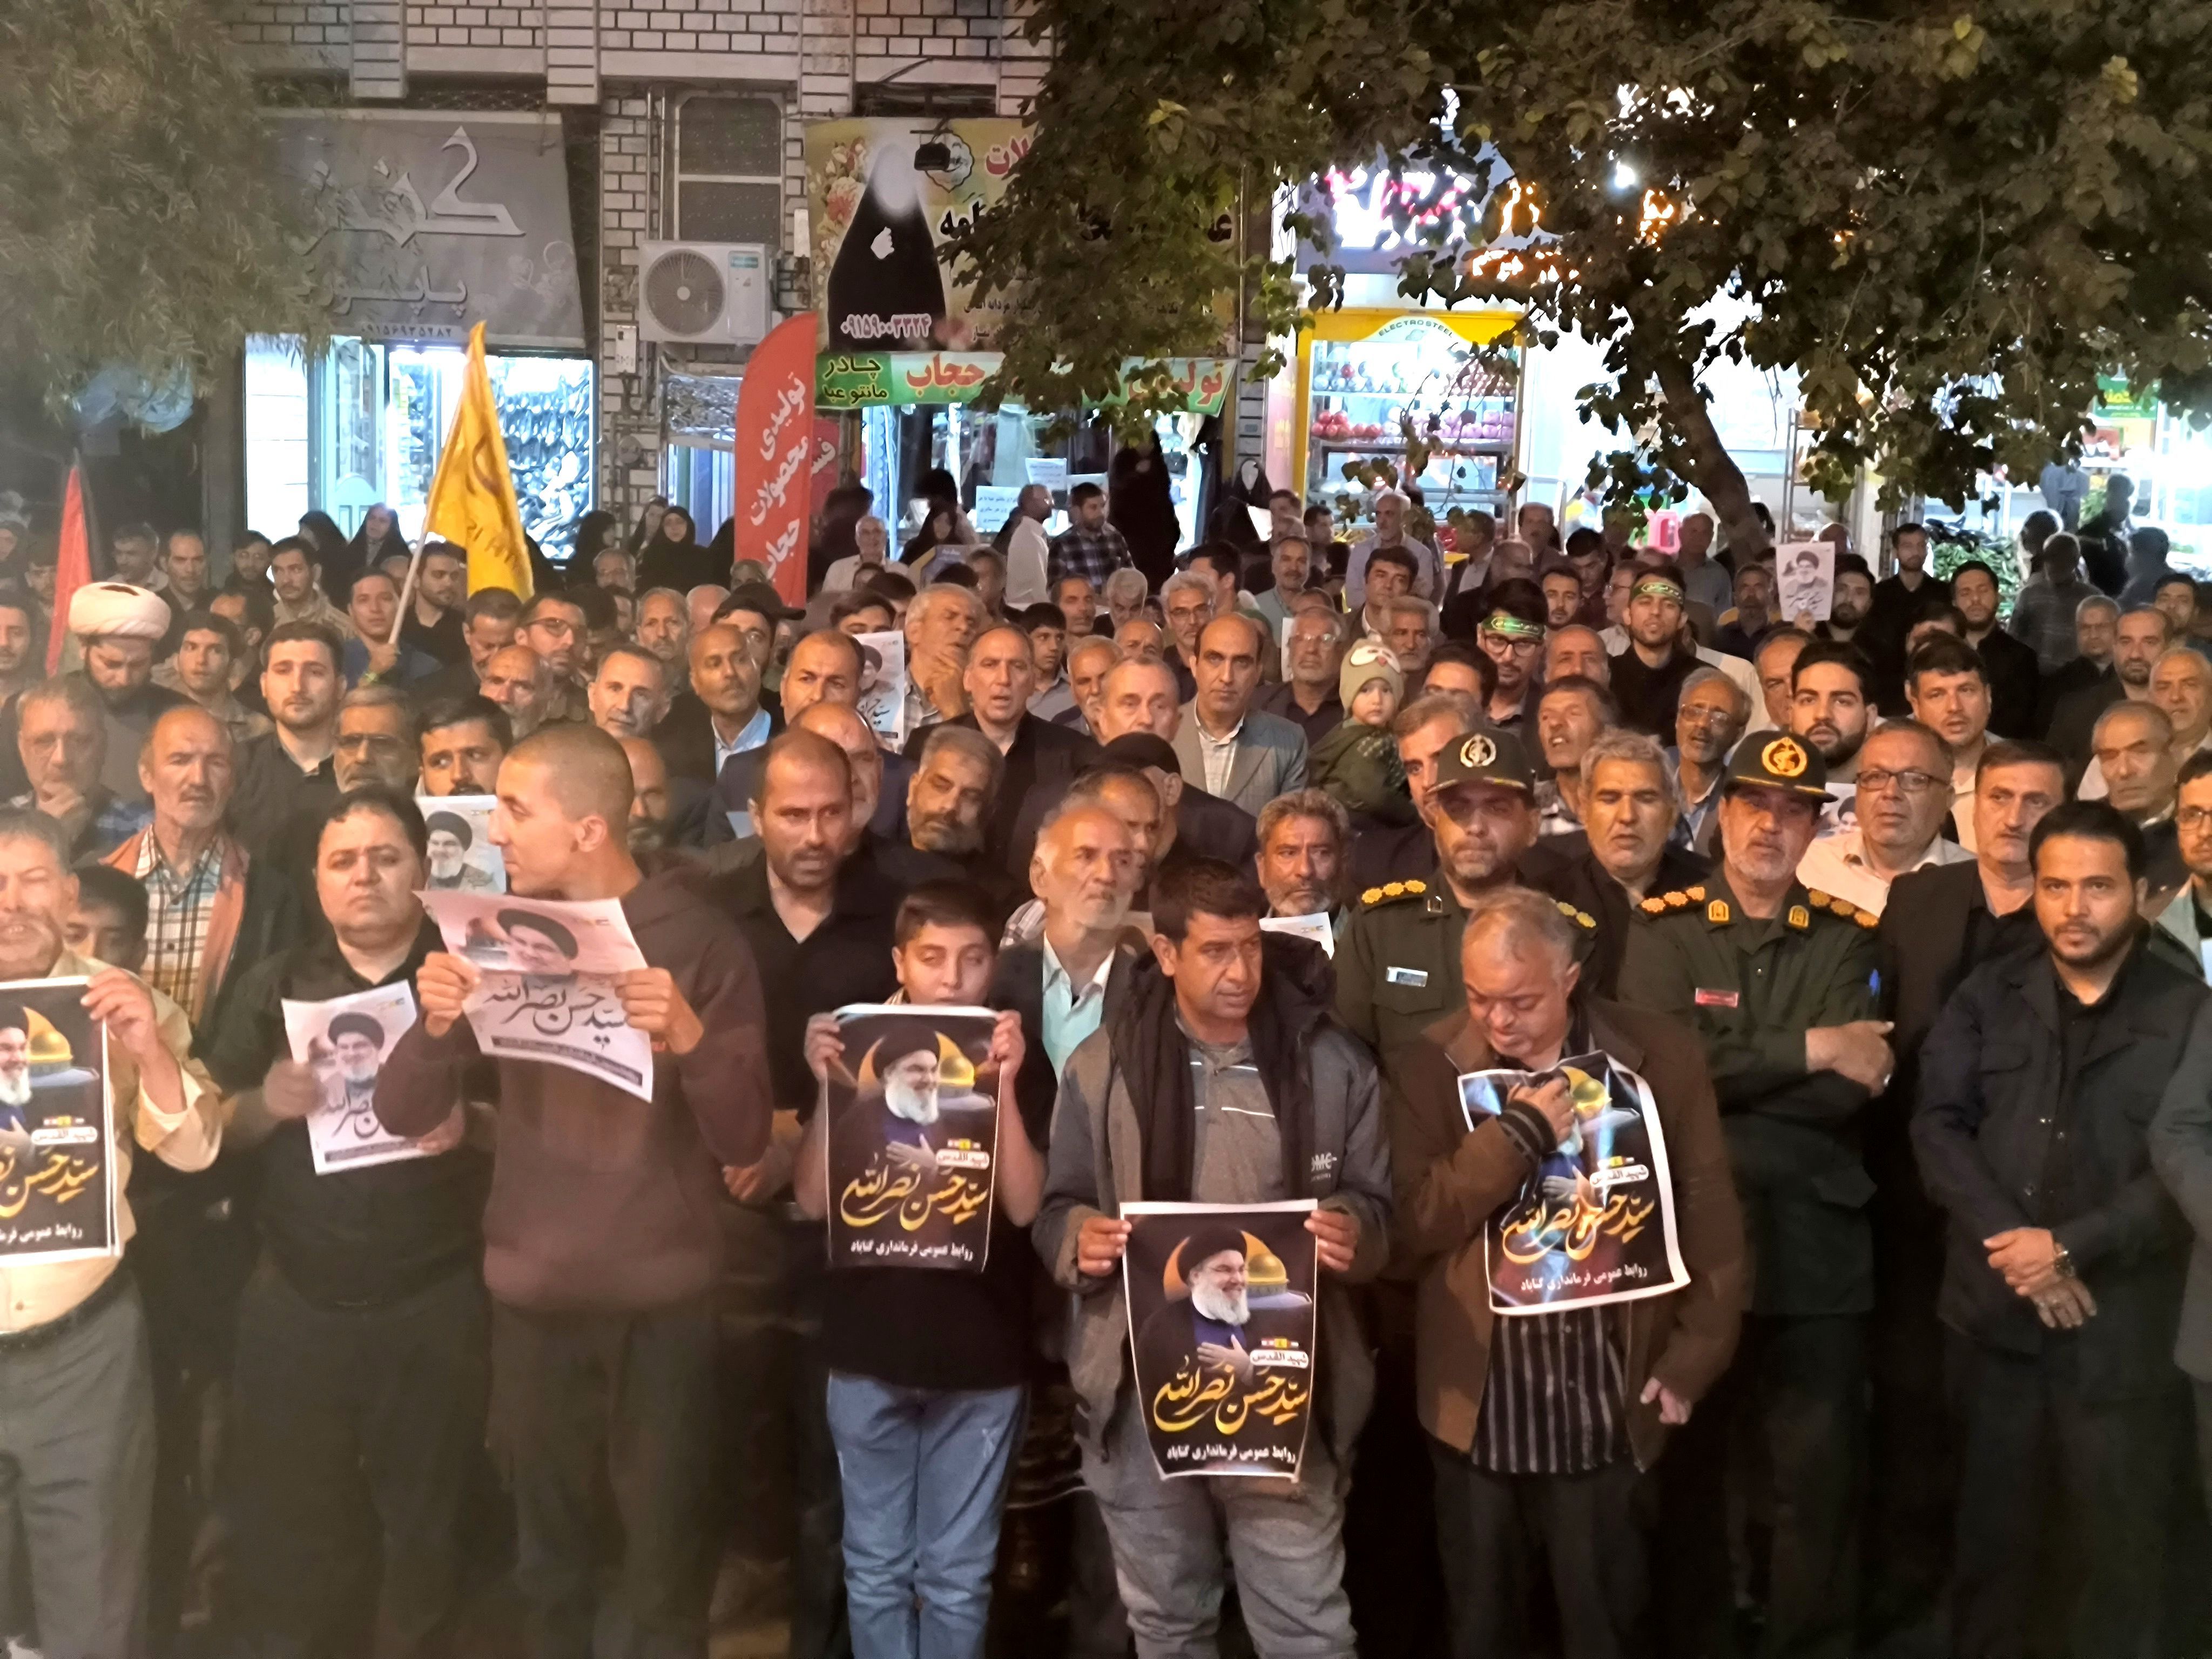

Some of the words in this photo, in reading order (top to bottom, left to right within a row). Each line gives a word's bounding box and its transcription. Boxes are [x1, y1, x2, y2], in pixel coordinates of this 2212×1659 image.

[824, 356, 882, 379] چادر
[906, 353, 986, 396] حجاب
[823, 385, 845, 398] عبا
[851, 384, 887, 404] مانتو
[760, 372, 806, 461] تولیدی
[750, 435, 808, 526] محصولات
[900, 1169, 967, 1231] حسن
[937, 1183, 989, 1225] سید
[1603, 1195, 1655, 1243] سید
[875, 1240, 918, 1256] فرمانداری
[920, 1245, 948, 1258] عمومی
[950, 1243, 973, 1262] روابط
[1594, 1267, 1622, 1284] عمومی
[1624, 1263, 1648, 1278] روابط
[1547, 1271, 1591, 1290] فرمانداری
[1252, 1352, 1285, 1363] القدس
[1287, 1354, 1307, 1366] شهید
[1215, 1367, 1286, 1435] حسن
[1255, 1381, 1308, 1426] سید
[1167, 1445, 1190, 1461] گناباد
[1192, 1444, 1238, 1460] فرمانداری
[1239, 1447, 1269, 1461] عمومی
[1272, 1445, 1296, 1464] روابط
